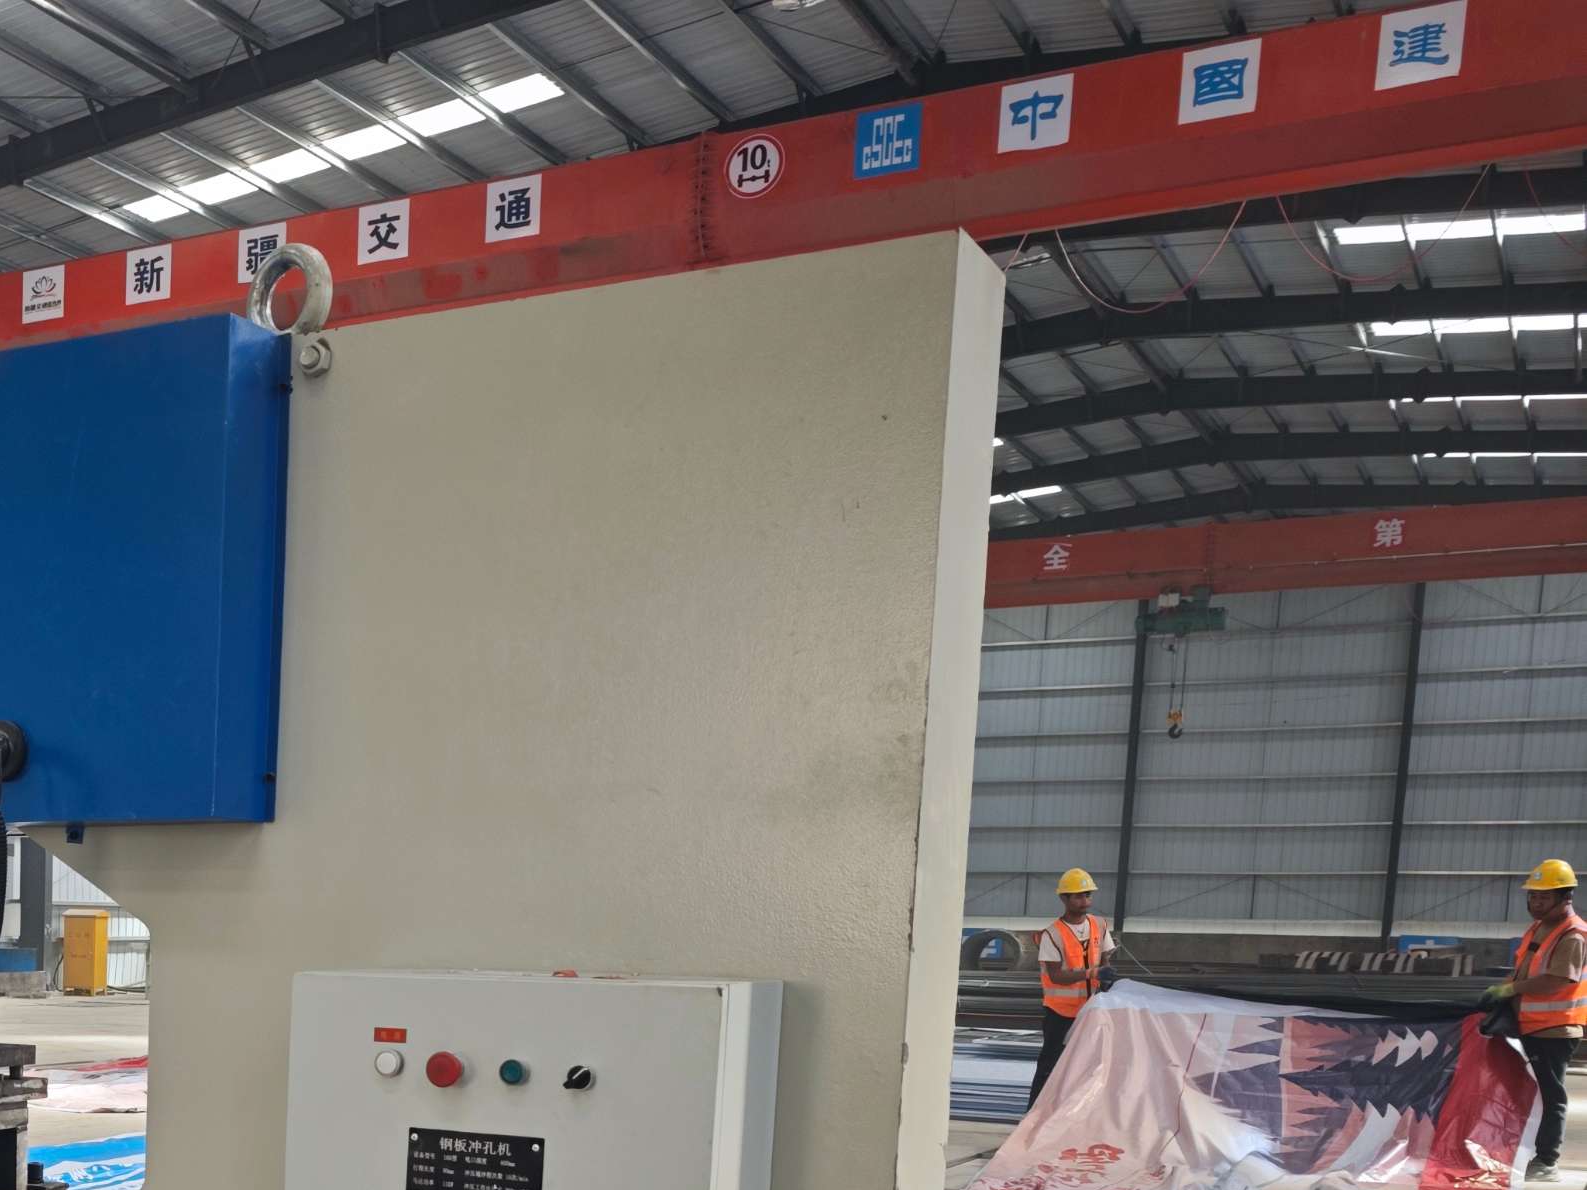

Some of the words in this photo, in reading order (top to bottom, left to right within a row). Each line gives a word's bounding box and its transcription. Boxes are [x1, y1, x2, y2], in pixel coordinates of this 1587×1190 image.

[1009, 90, 1064, 141] 中
[1193, 58, 1249, 108] 國
[1389, 23, 1450, 67] 建
[133, 255, 164, 295] 新
[367, 213, 401, 254] 交
[494, 187, 532, 231] 通
[1043, 544, 1071, 571] 全
[1373, 518, 1405, 548] 第
[439, 1136, 512, 1157] 钢板冲孔机
